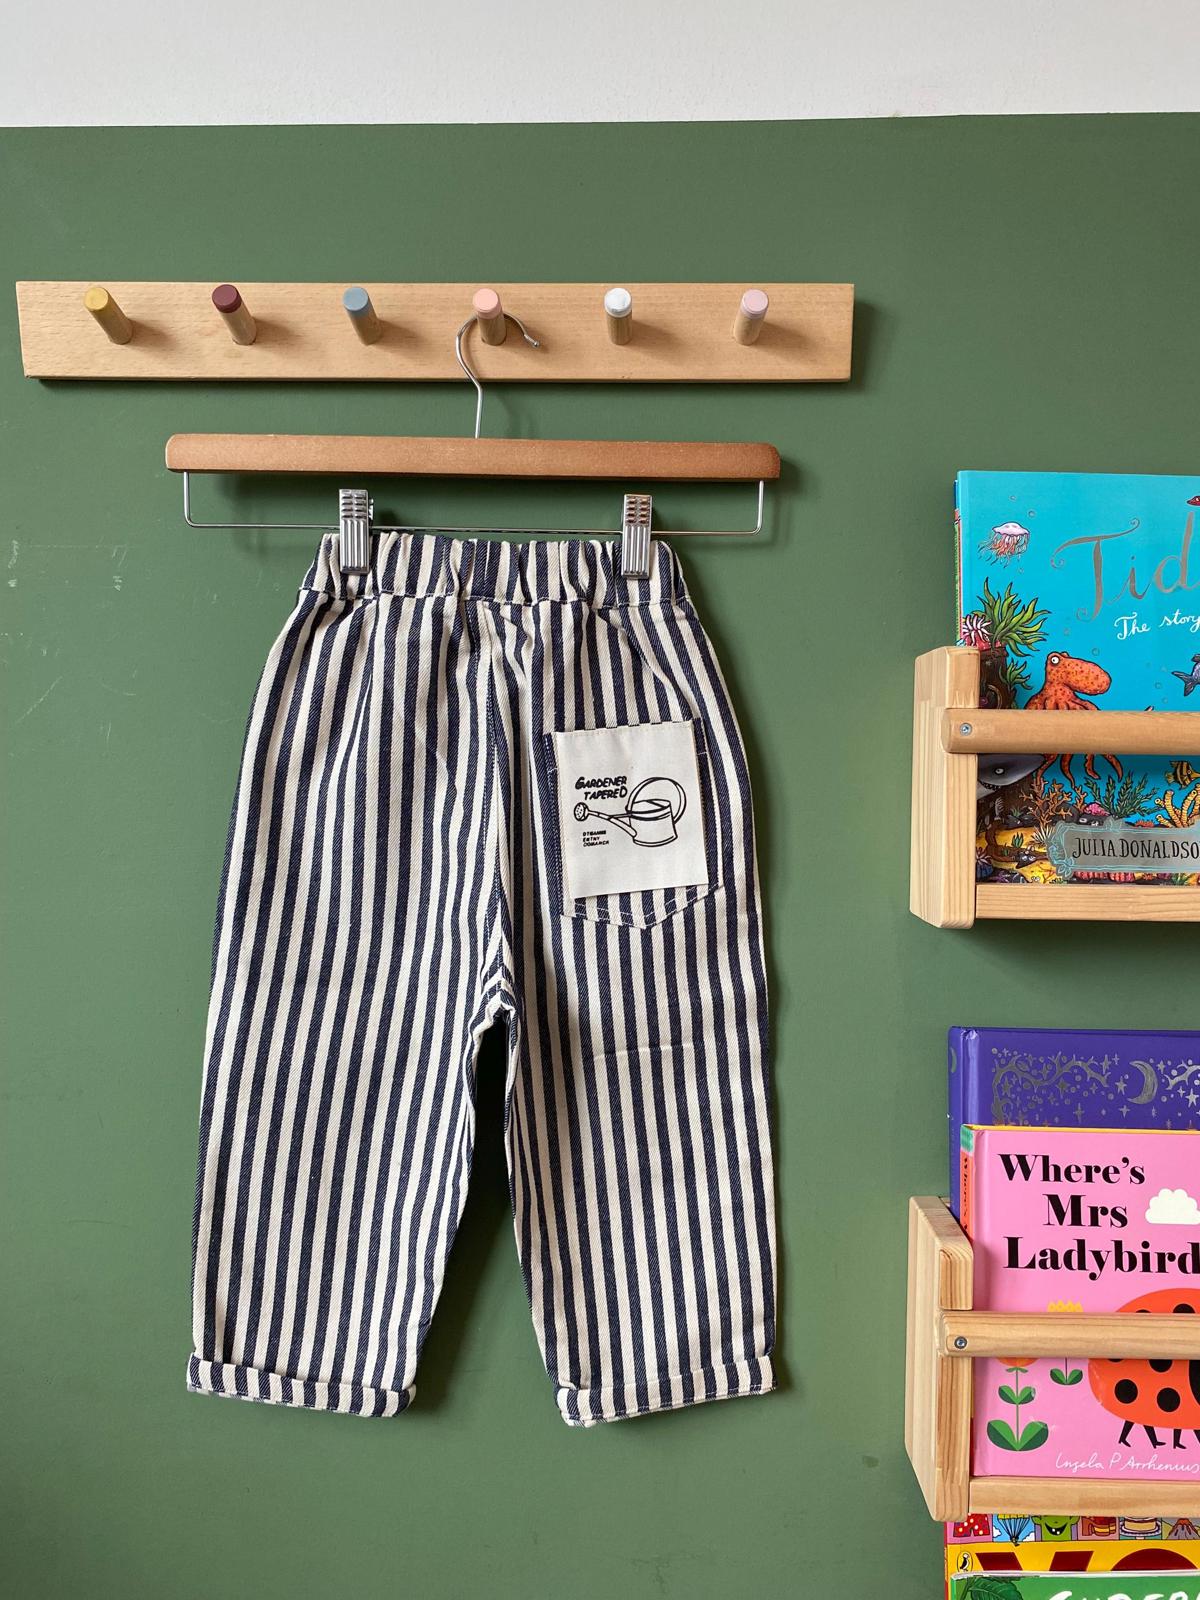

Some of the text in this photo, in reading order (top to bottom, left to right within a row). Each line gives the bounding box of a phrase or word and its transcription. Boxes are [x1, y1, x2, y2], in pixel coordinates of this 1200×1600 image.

[1050, 511, 1200, 623] Tid
[1114, 608, 1200, 640] The story
[575, 775, 627, 790] GARDENER
[584, 786, 628, 800] TAPERED
[1072, 838, 1117, 859] JULIA
[998, 1153, 1145, 1185] Where's
[1043, 1194, 1128, 1228] Mrs
[1003, 1236, 1200, 1281] Ladybird
[1055, 1452, 1104, 1473] Ingela
[1109, 1452, 1122, 1469] P
